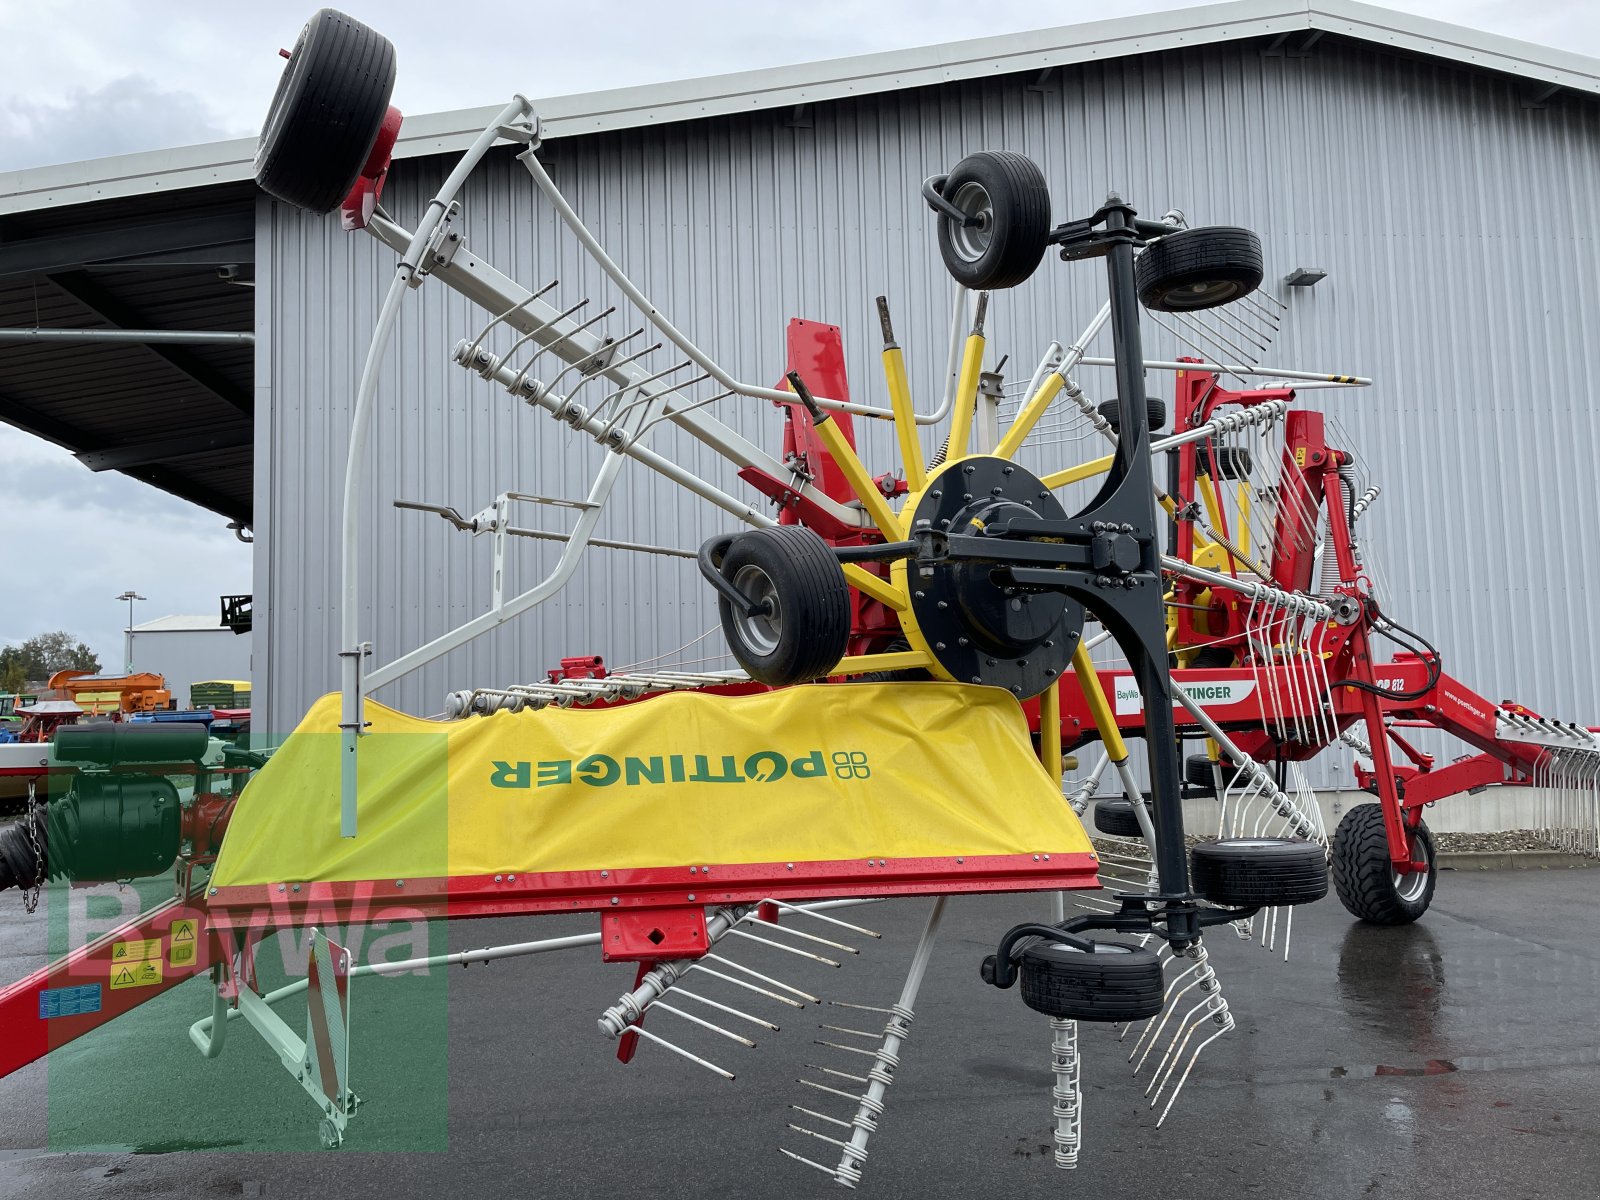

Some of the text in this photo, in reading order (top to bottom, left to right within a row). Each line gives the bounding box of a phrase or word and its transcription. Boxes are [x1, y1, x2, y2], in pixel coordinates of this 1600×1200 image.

[1376, 678, 1405, 691] OP 812
[1117, 689, 1138, 700] BayWa
[1183, 686, 1231, 699] TINGER
[1444, 690, 1486, 719] www.poettinger.at
